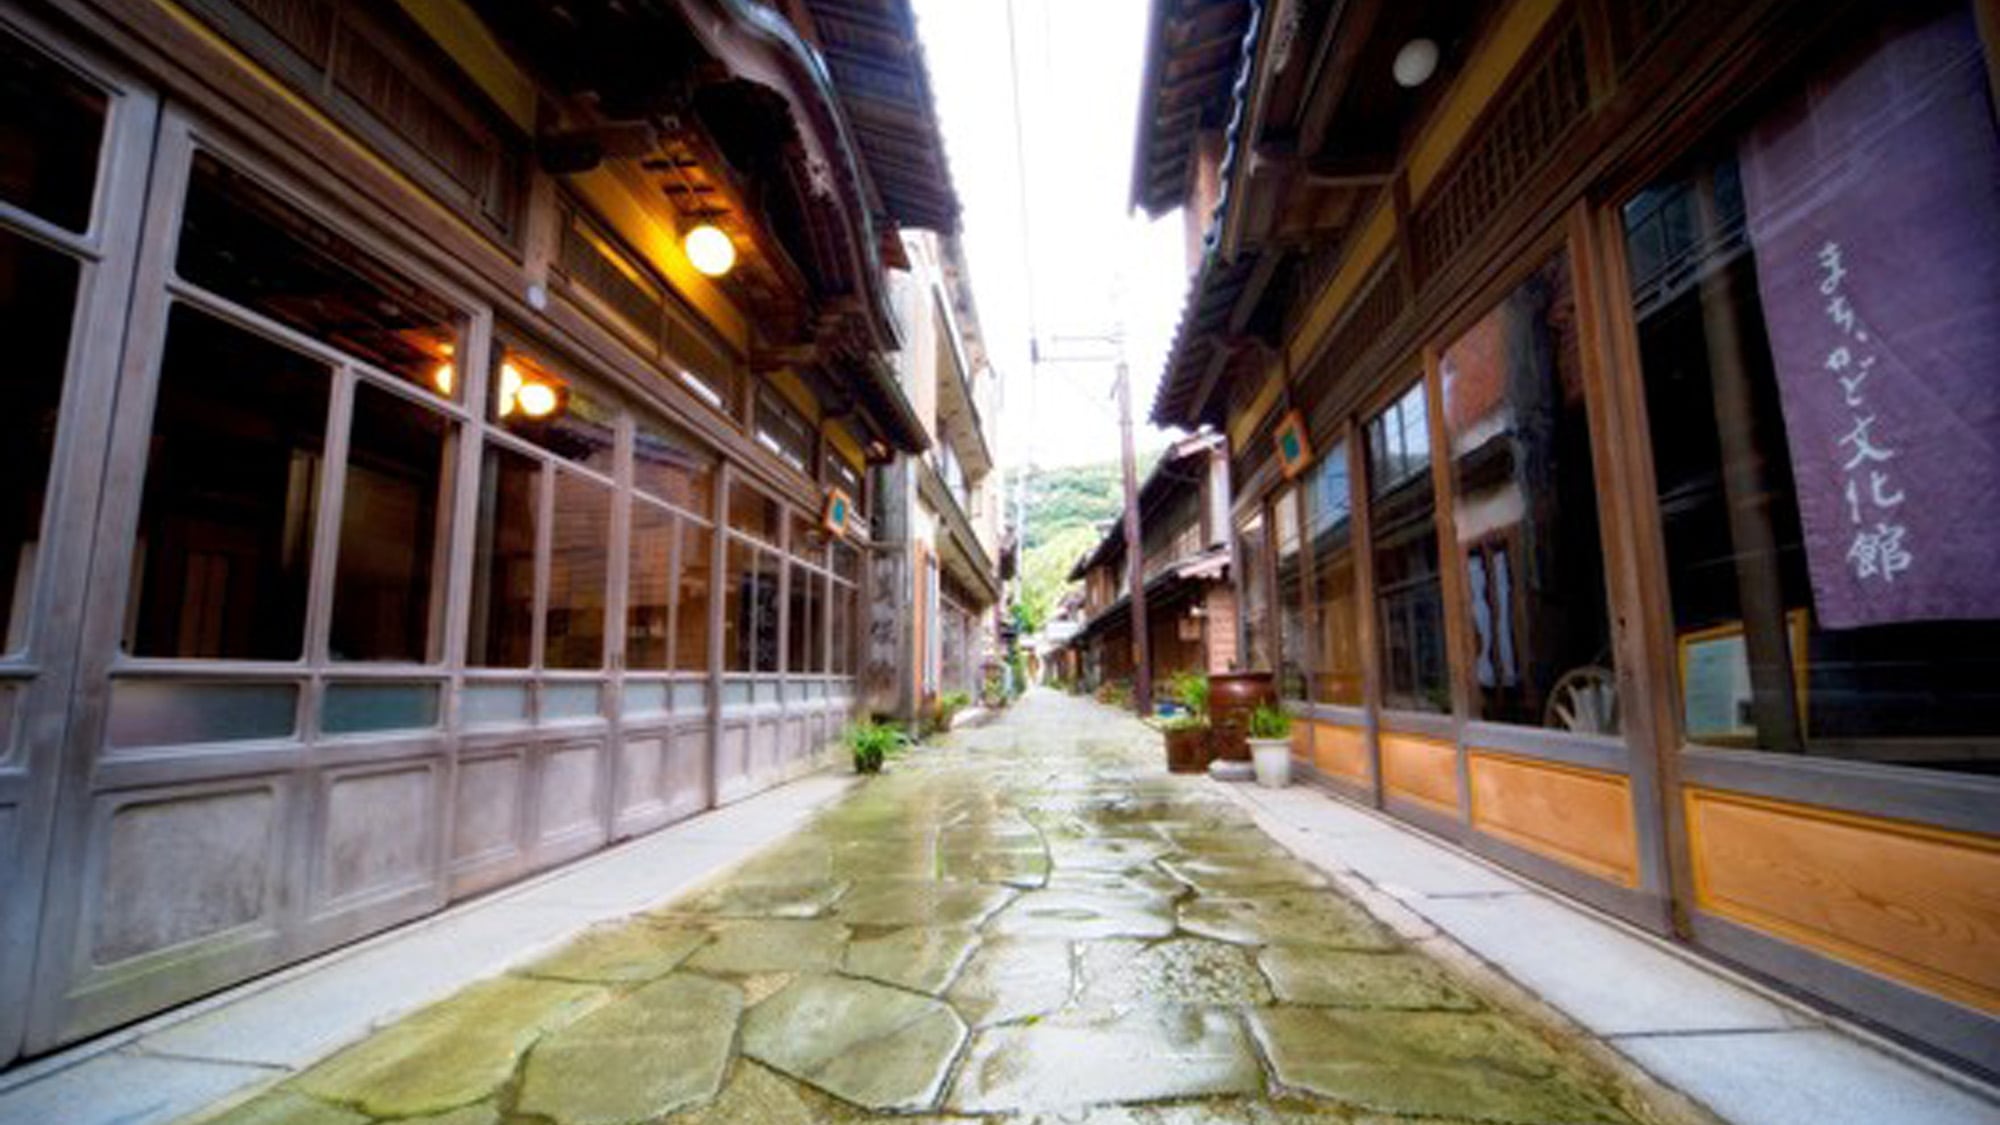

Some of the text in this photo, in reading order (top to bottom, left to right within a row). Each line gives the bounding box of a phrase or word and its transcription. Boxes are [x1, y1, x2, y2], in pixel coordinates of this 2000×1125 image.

[1818, 242, 1912, 580] まちかど文化館
